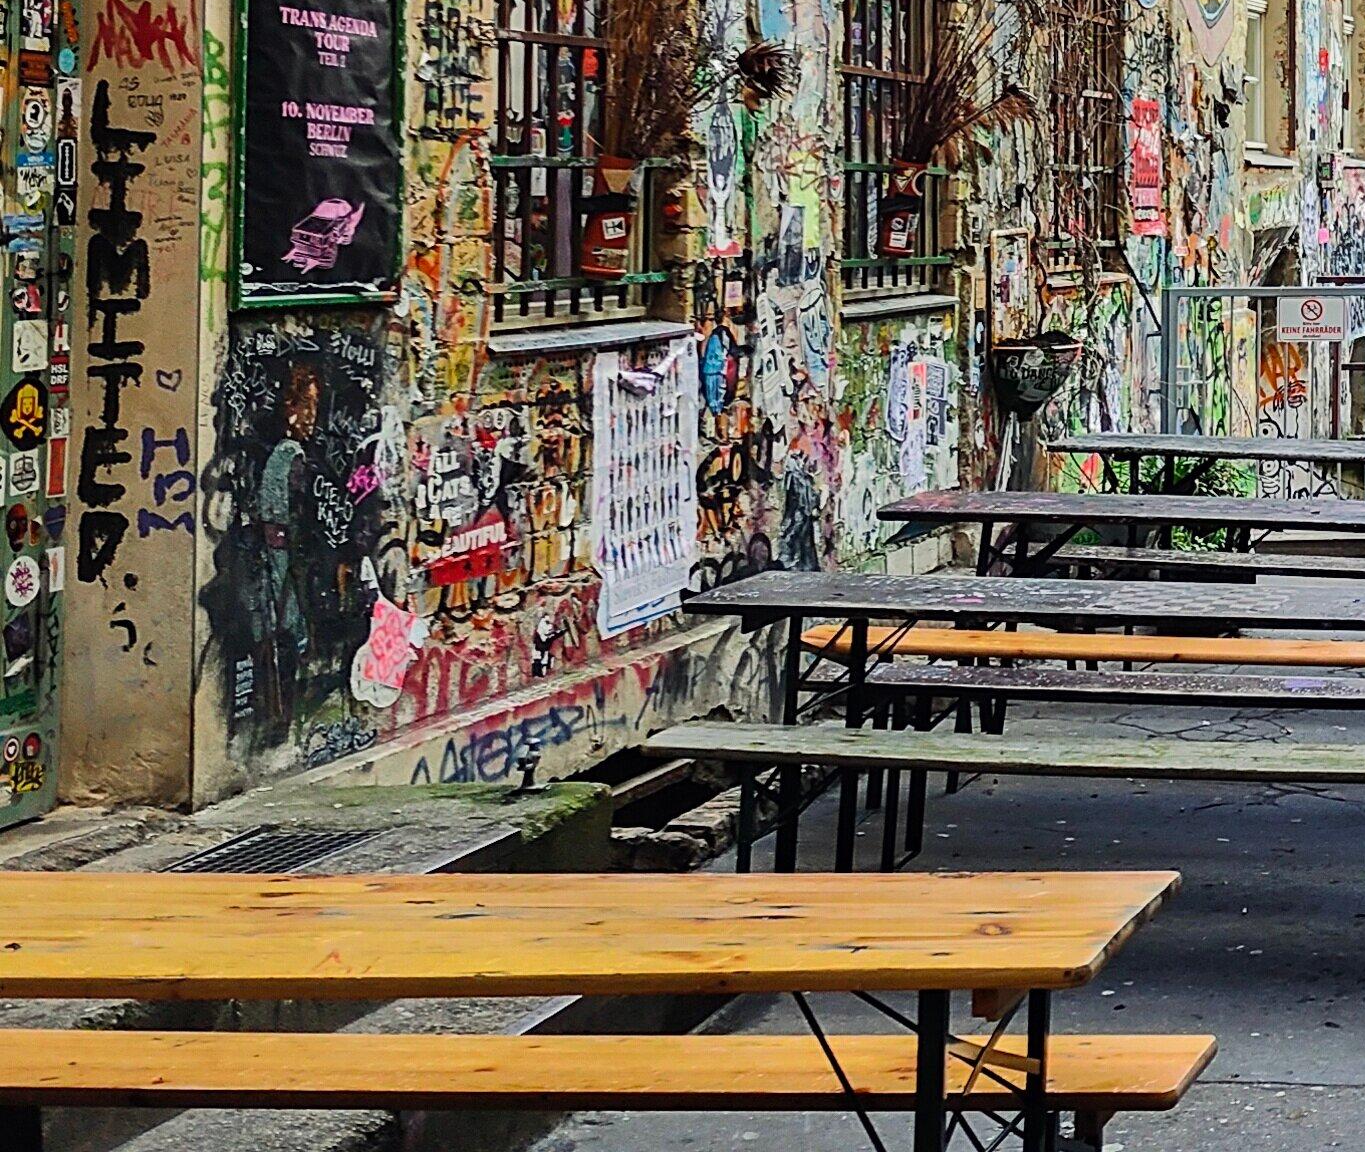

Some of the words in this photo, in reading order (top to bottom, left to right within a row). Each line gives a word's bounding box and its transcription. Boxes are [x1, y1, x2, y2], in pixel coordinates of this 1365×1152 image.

[279, 5, 327, 29] TRANS
[329, 13, 378, 38] AGENDA
[314, 31, 351, 53] TOUR
[281, 101, 303, 119] 10.
[305, 102, 376, 126] NOVEMBER
[306, 122, 352, 143] BERLIN
[1281, 326, 1301, 334] KEINE
[1302, 325, 1342, 334] FAHRRÄDER
[441, 521, 508, 556] EAUTIFUL
